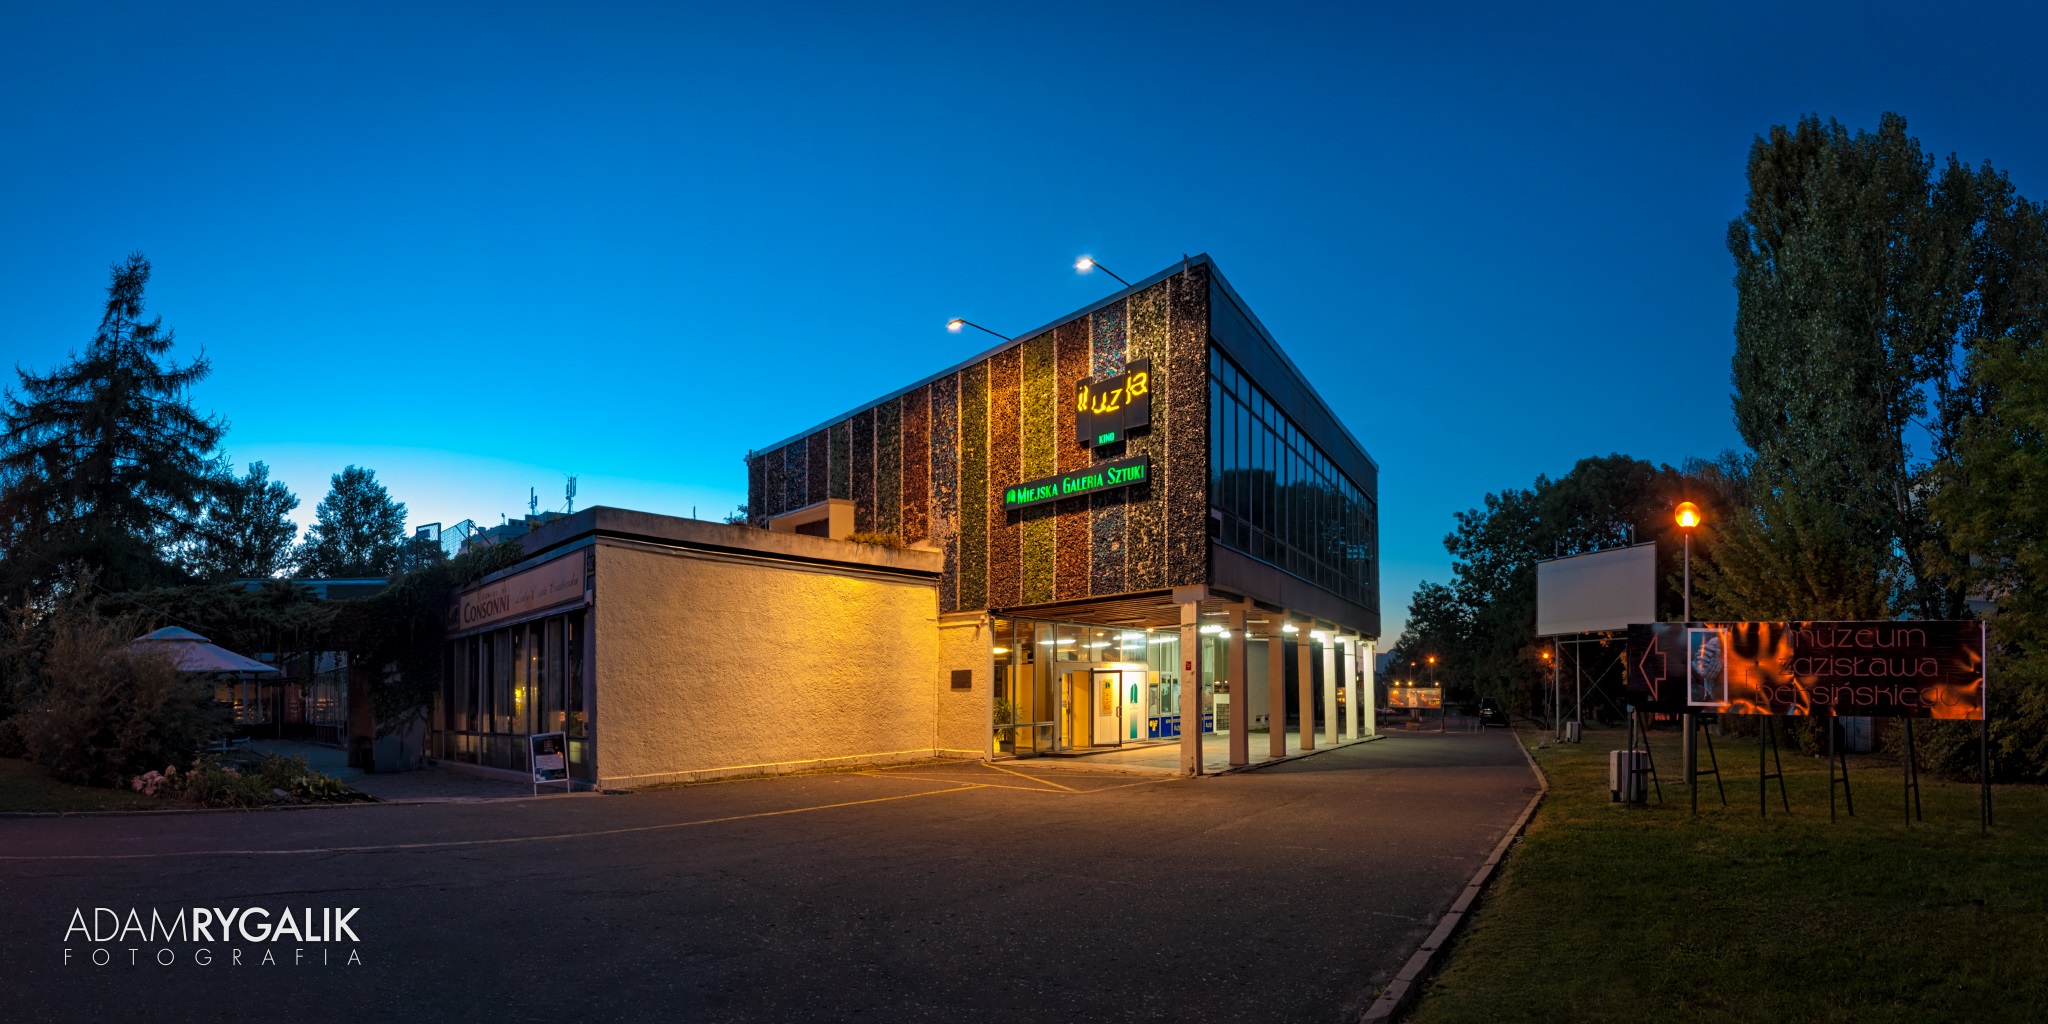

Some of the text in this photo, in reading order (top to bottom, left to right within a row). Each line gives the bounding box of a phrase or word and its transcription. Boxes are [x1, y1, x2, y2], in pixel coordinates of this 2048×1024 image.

[1077, 370, 1148, 414] iluzja
[1098, 432, 1115, 445] KINO
[1790, 628, 1927, 648] muzeum
